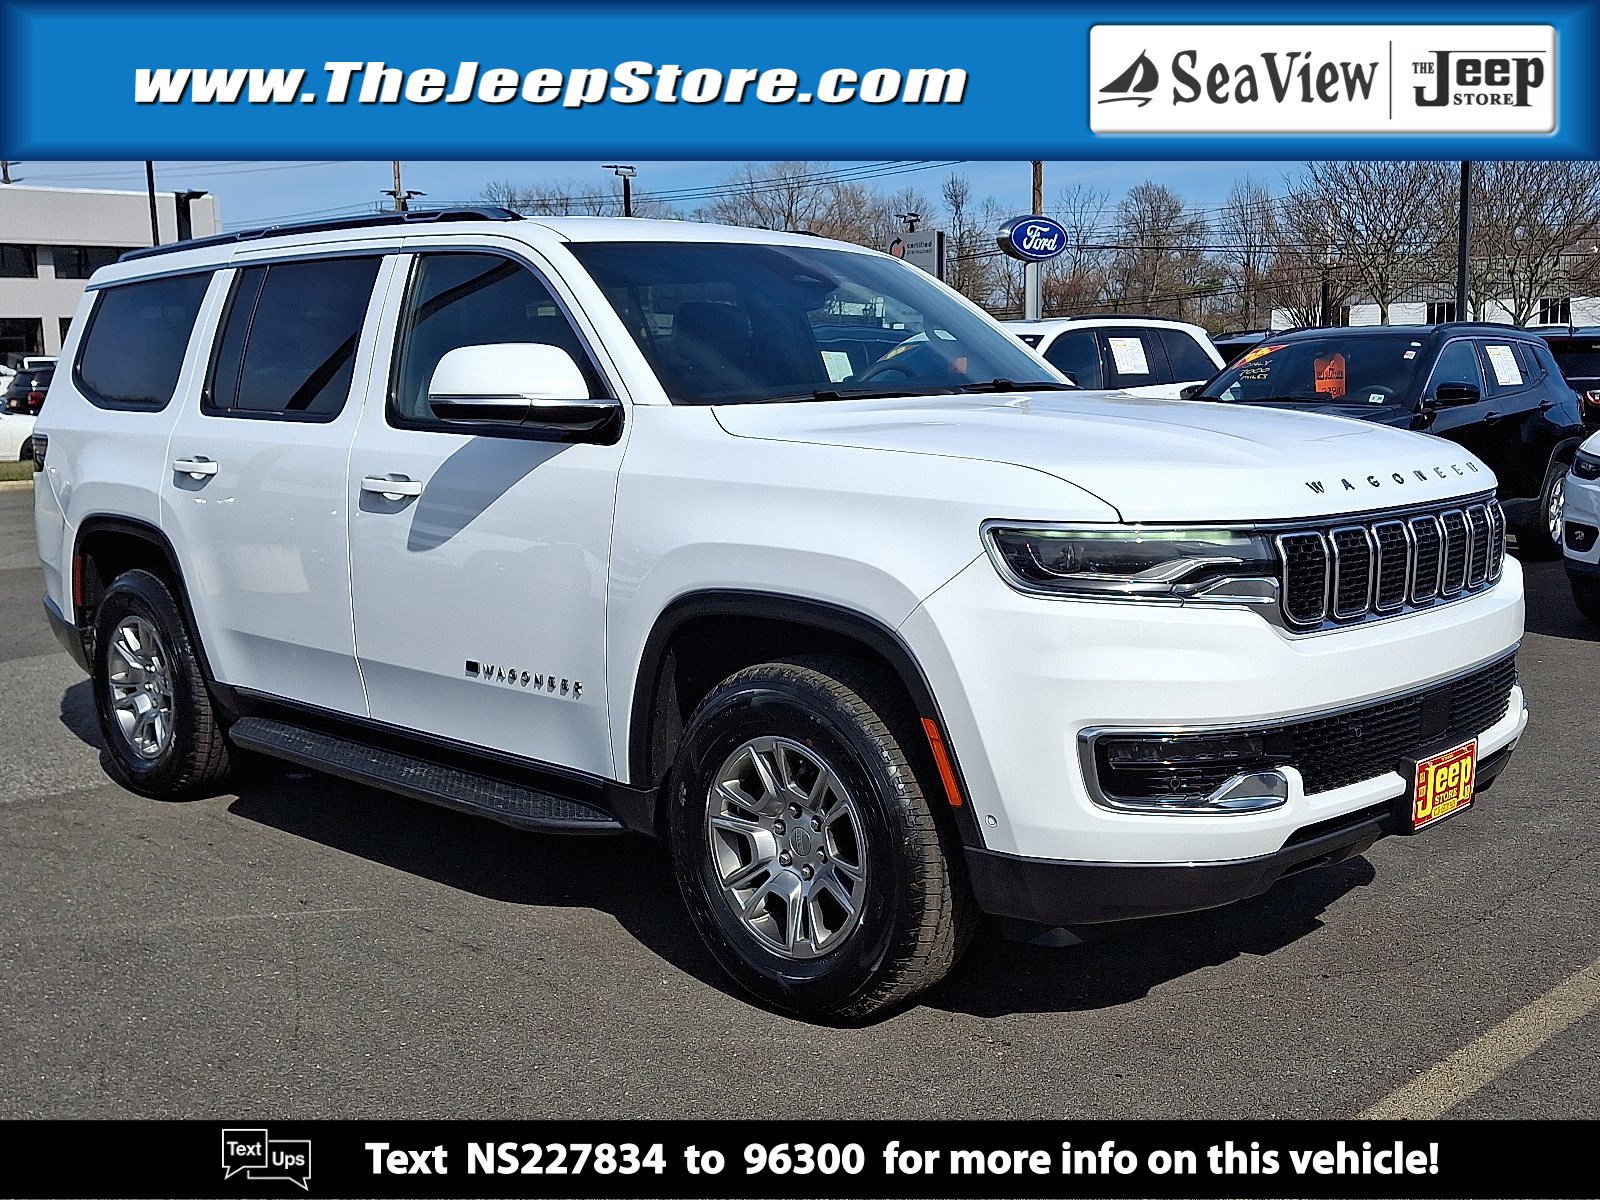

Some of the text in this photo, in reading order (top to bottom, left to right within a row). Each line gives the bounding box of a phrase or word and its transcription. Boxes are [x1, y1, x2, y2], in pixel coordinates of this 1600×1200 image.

[1023, 225, 1058, 251] Ford
[482, 663, 584, 697] WAGONEER
[1417, 756, 1472, 819] Jeep
[1434, 787, 1458, 805] STORE
